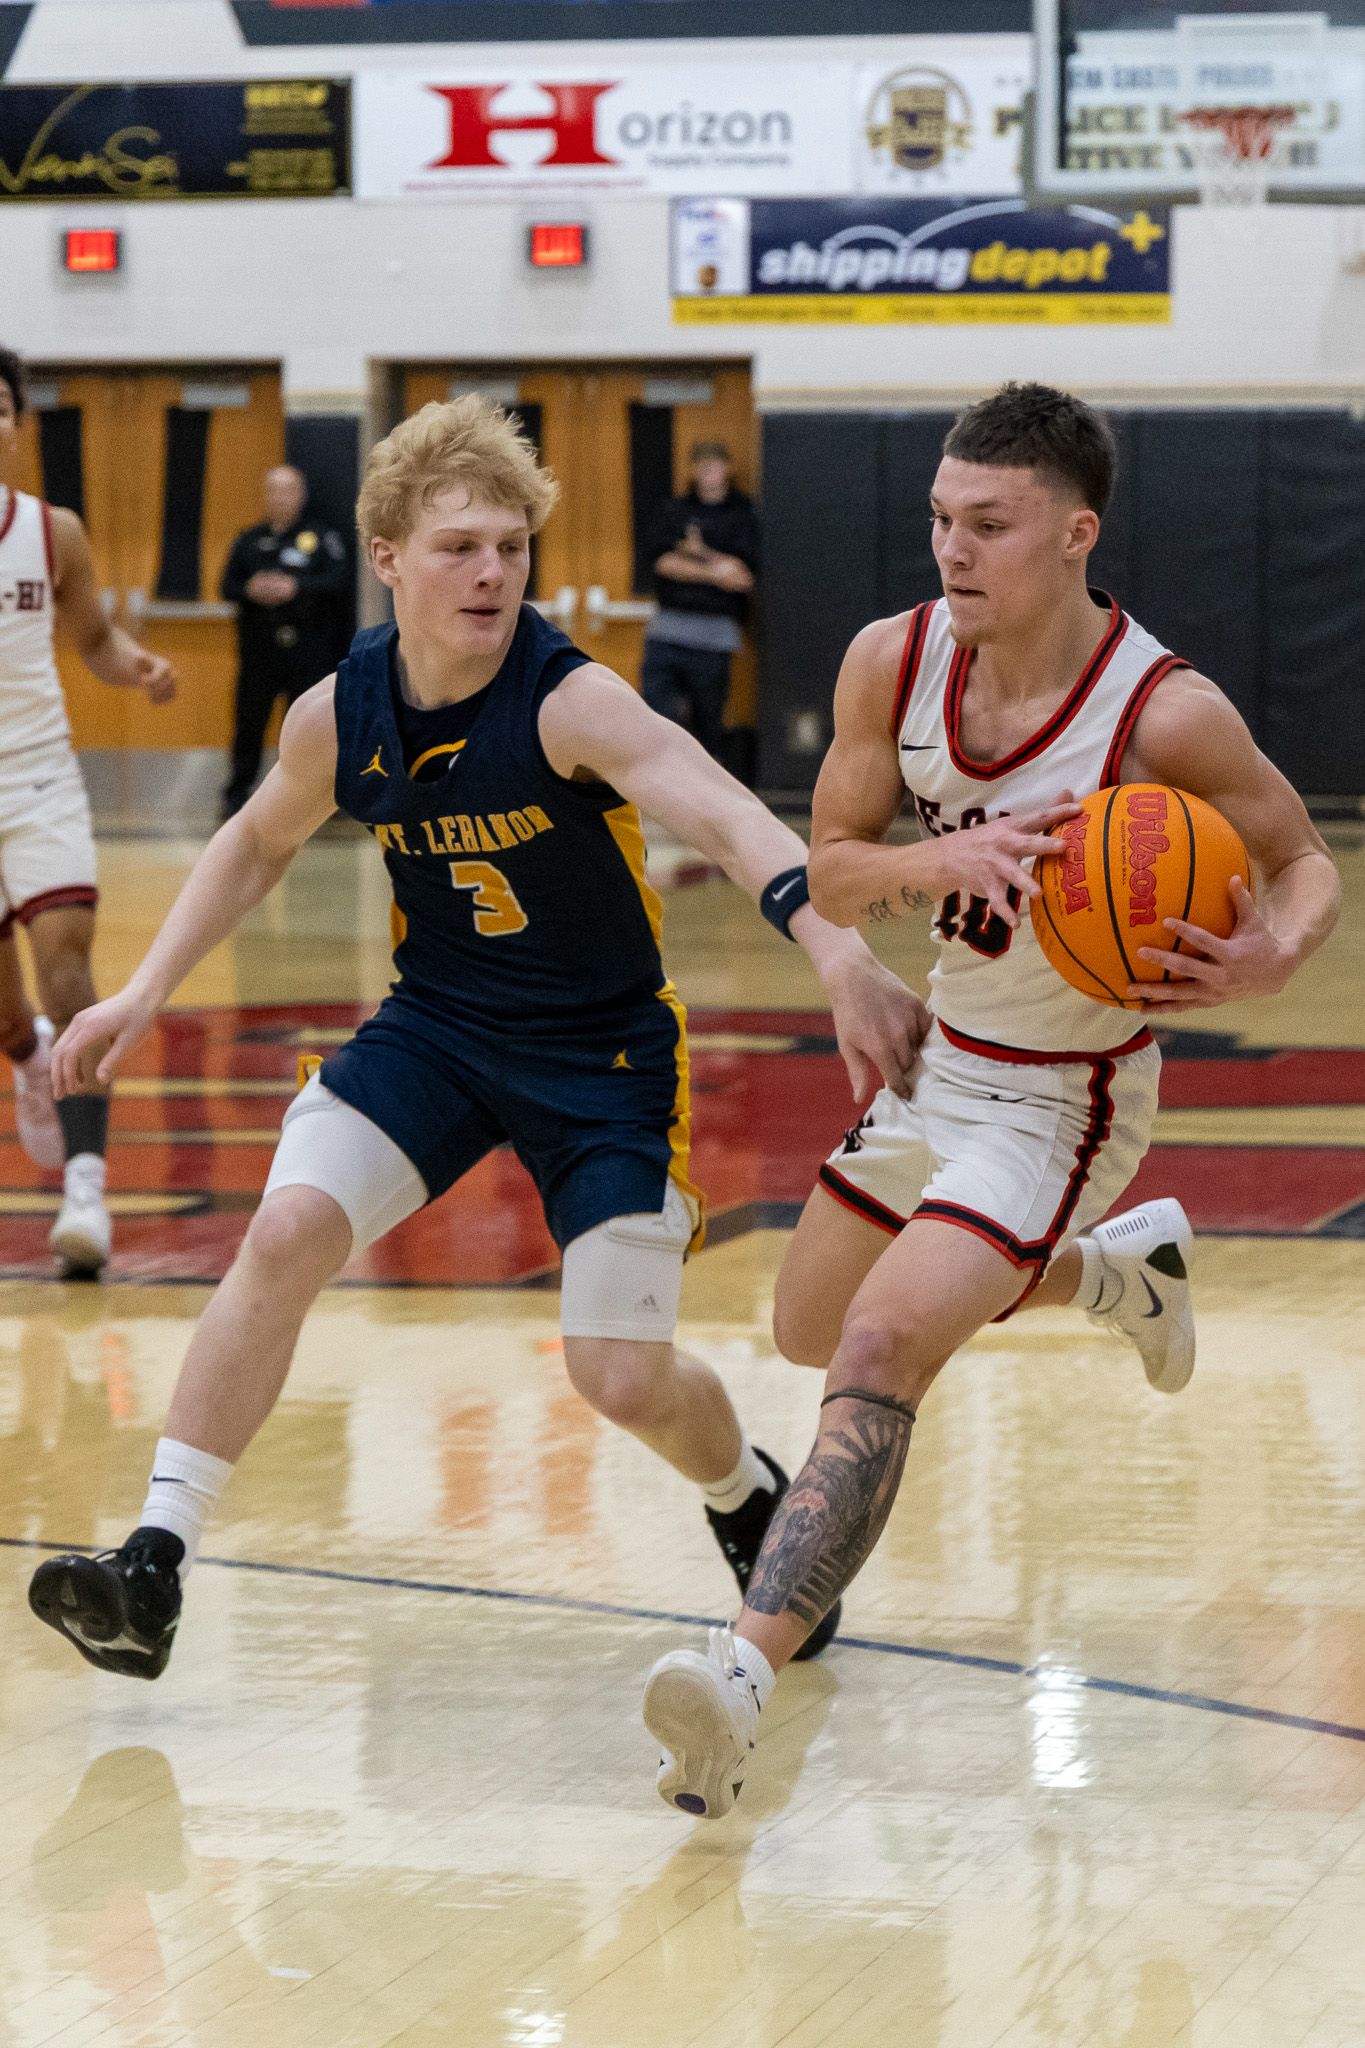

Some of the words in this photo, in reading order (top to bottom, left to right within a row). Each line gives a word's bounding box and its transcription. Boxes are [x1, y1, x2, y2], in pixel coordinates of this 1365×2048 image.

[415, 83, 792, 169] Horizon
[0, 580, 44, 612] -HI
[420, 804, 554, 855] LEBANON
[1060, 814, 1092, 916] NCAA
[1126, 792, 1171, 928] Wilson
[449, 861, 529, 937] 3
